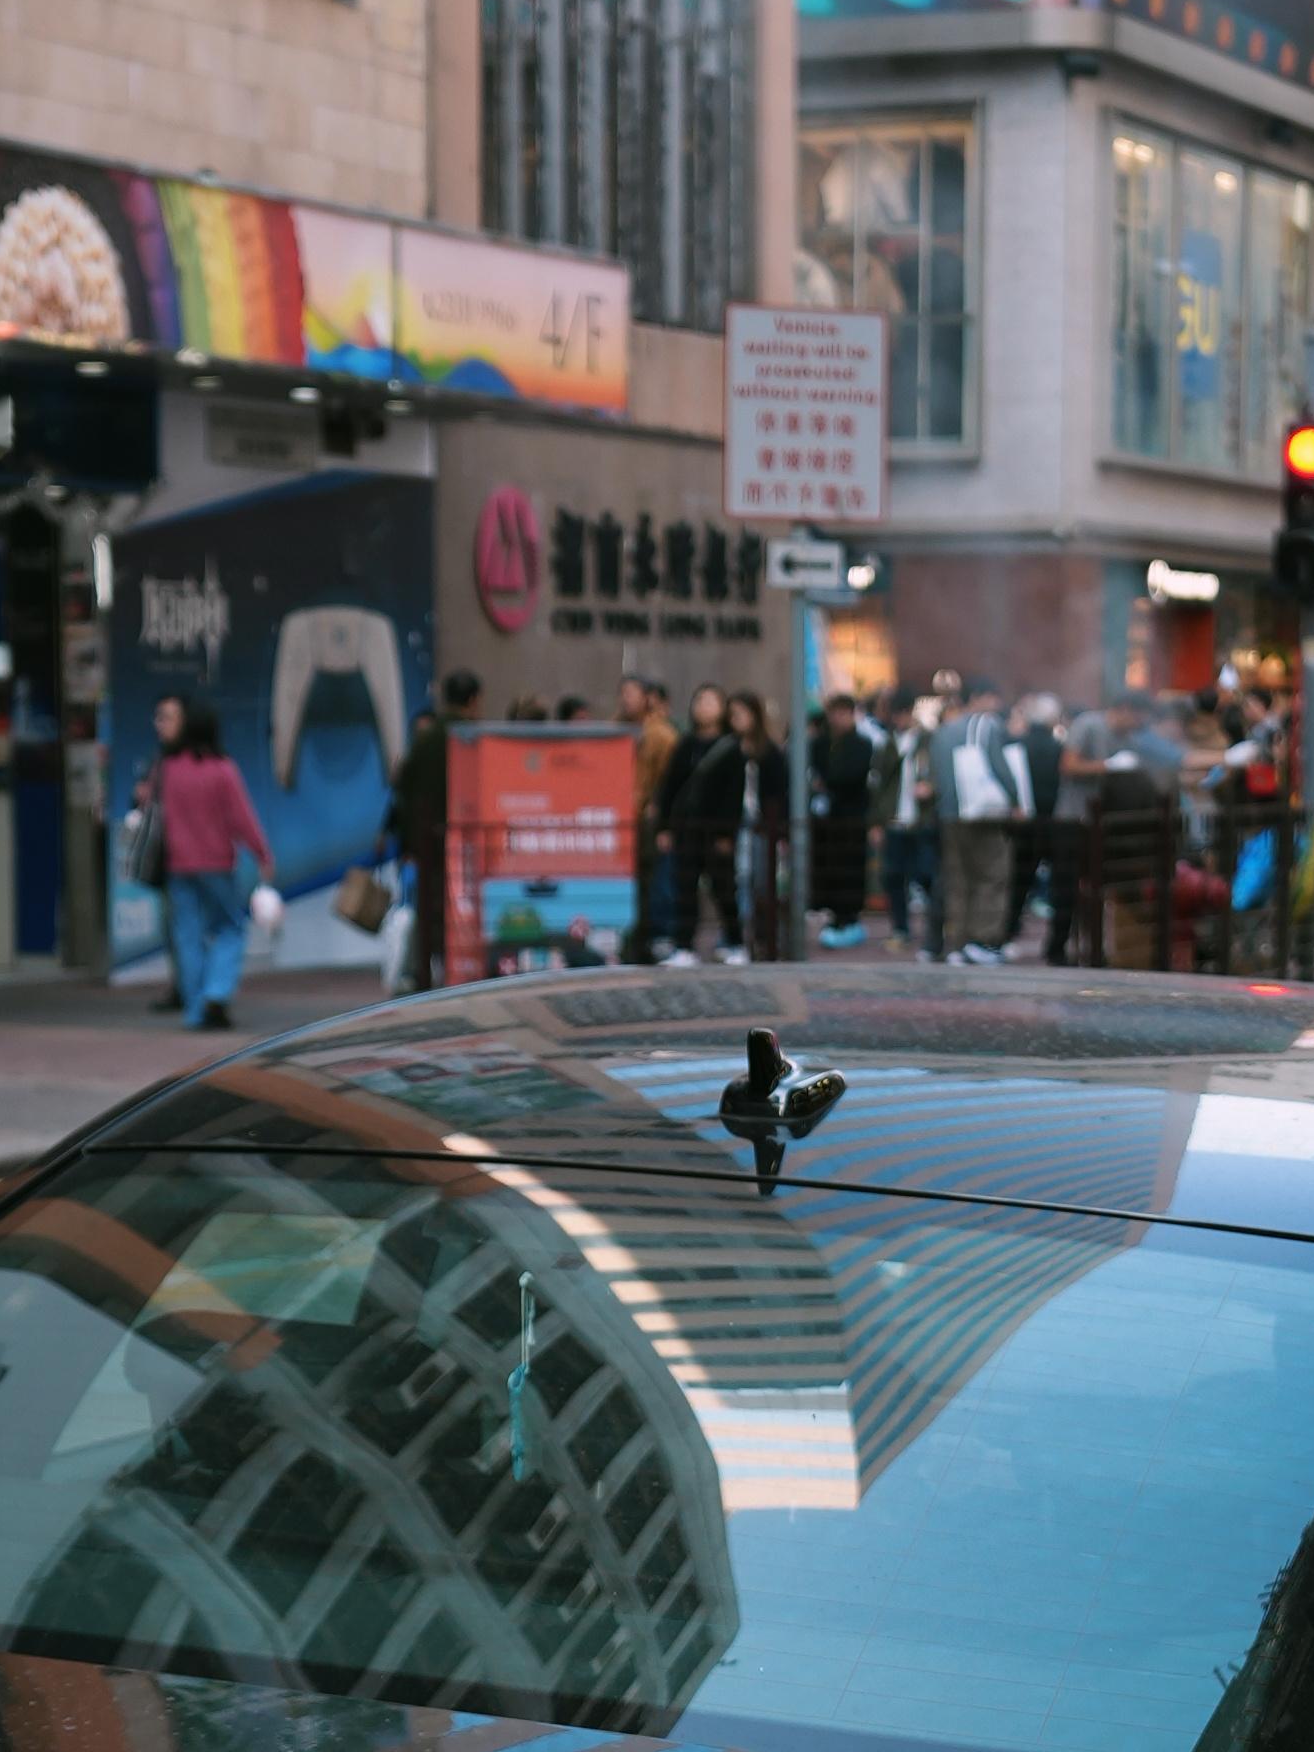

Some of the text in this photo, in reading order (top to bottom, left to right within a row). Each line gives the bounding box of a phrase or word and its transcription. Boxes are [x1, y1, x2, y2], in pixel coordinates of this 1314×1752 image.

[743, 340, 807, 359] waiting
[734, 384, 876, 407] without warning
